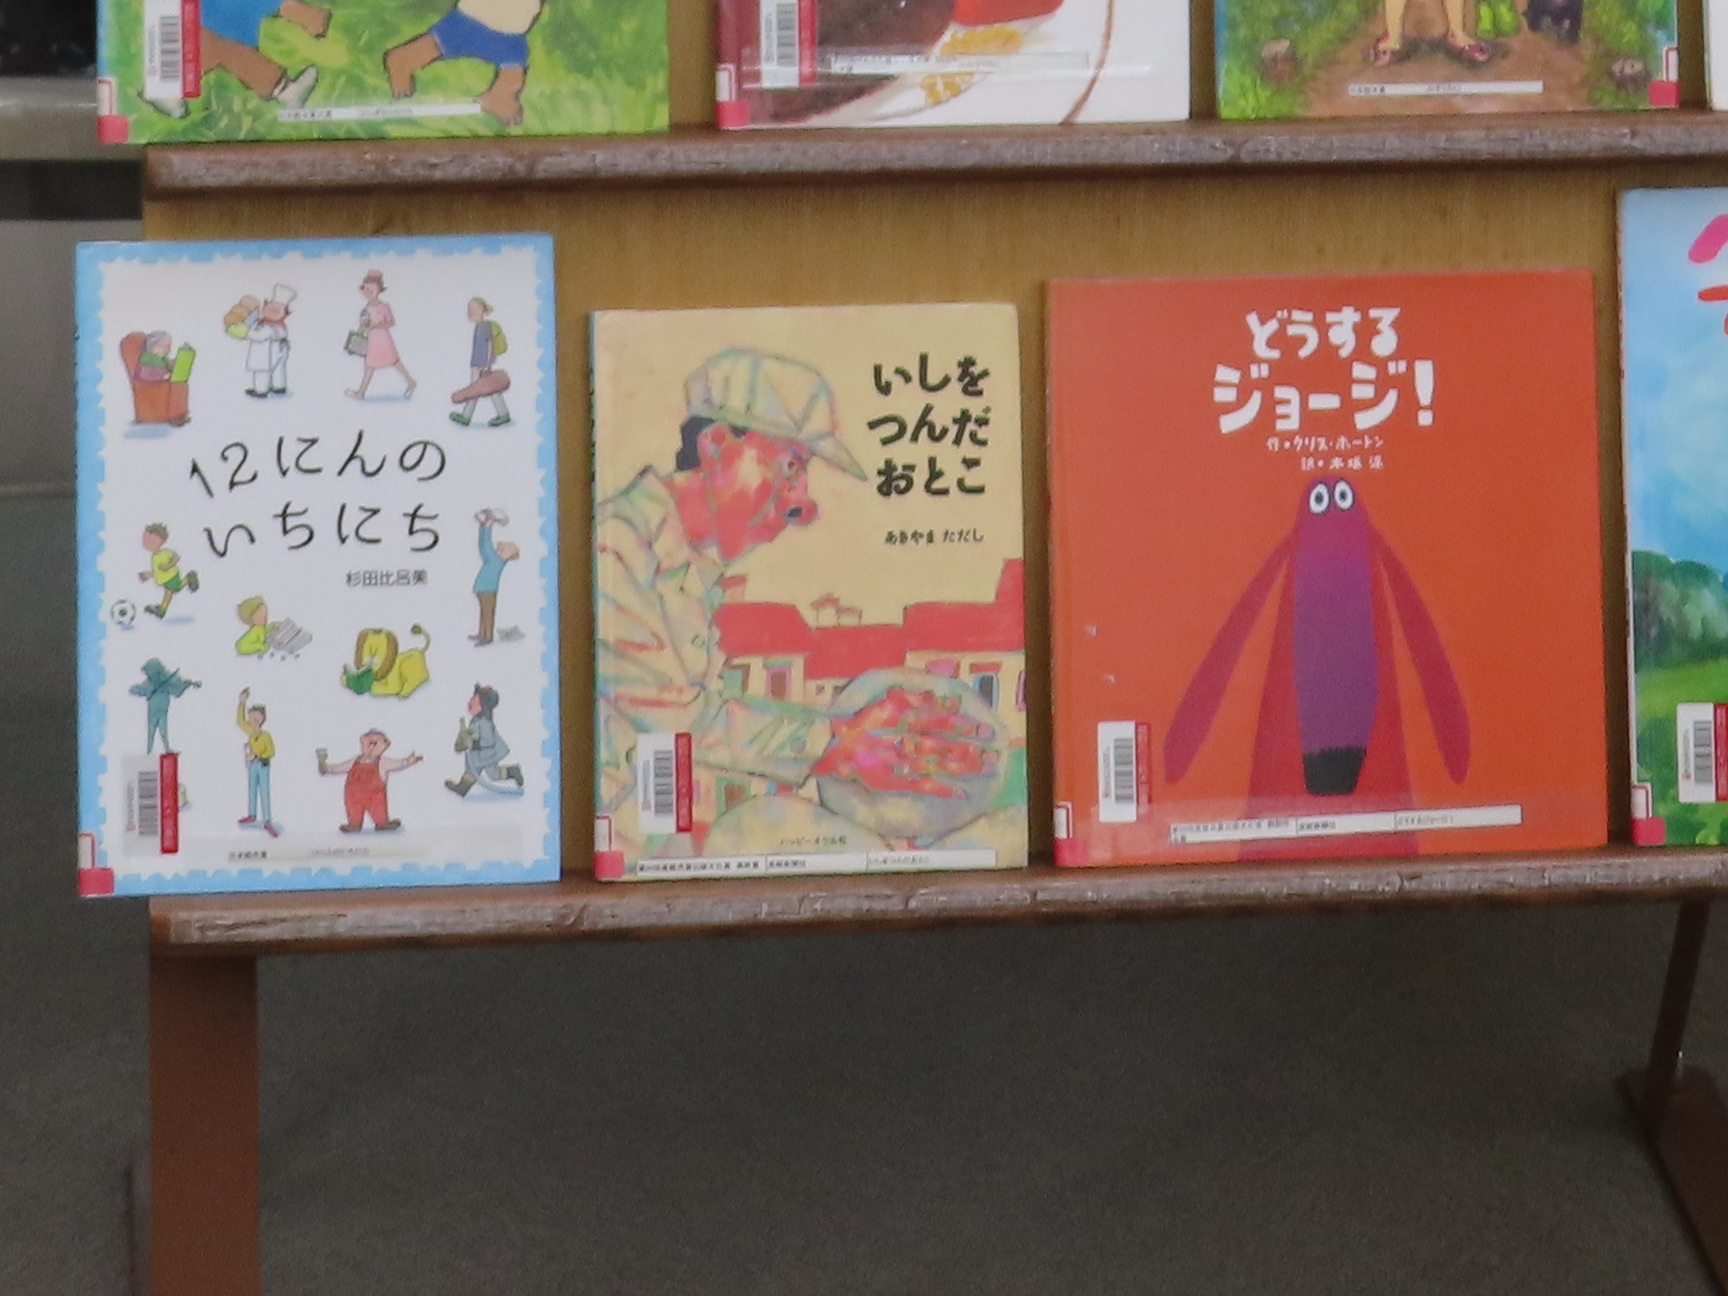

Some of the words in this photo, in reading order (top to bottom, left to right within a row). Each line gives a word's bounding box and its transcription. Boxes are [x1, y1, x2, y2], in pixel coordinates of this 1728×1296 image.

[1244, 305, 1402, 359] どうする
[872, 352, 991, 398] いしを
[1212, 359, 1436, 434] ジョージ！
[867, 403, 991, 447] つんだ
[188, 428, 449, 499] 12にんの
[875, 456, 988, 499] おとこ
[202, 498, 441, 559] いちにち
